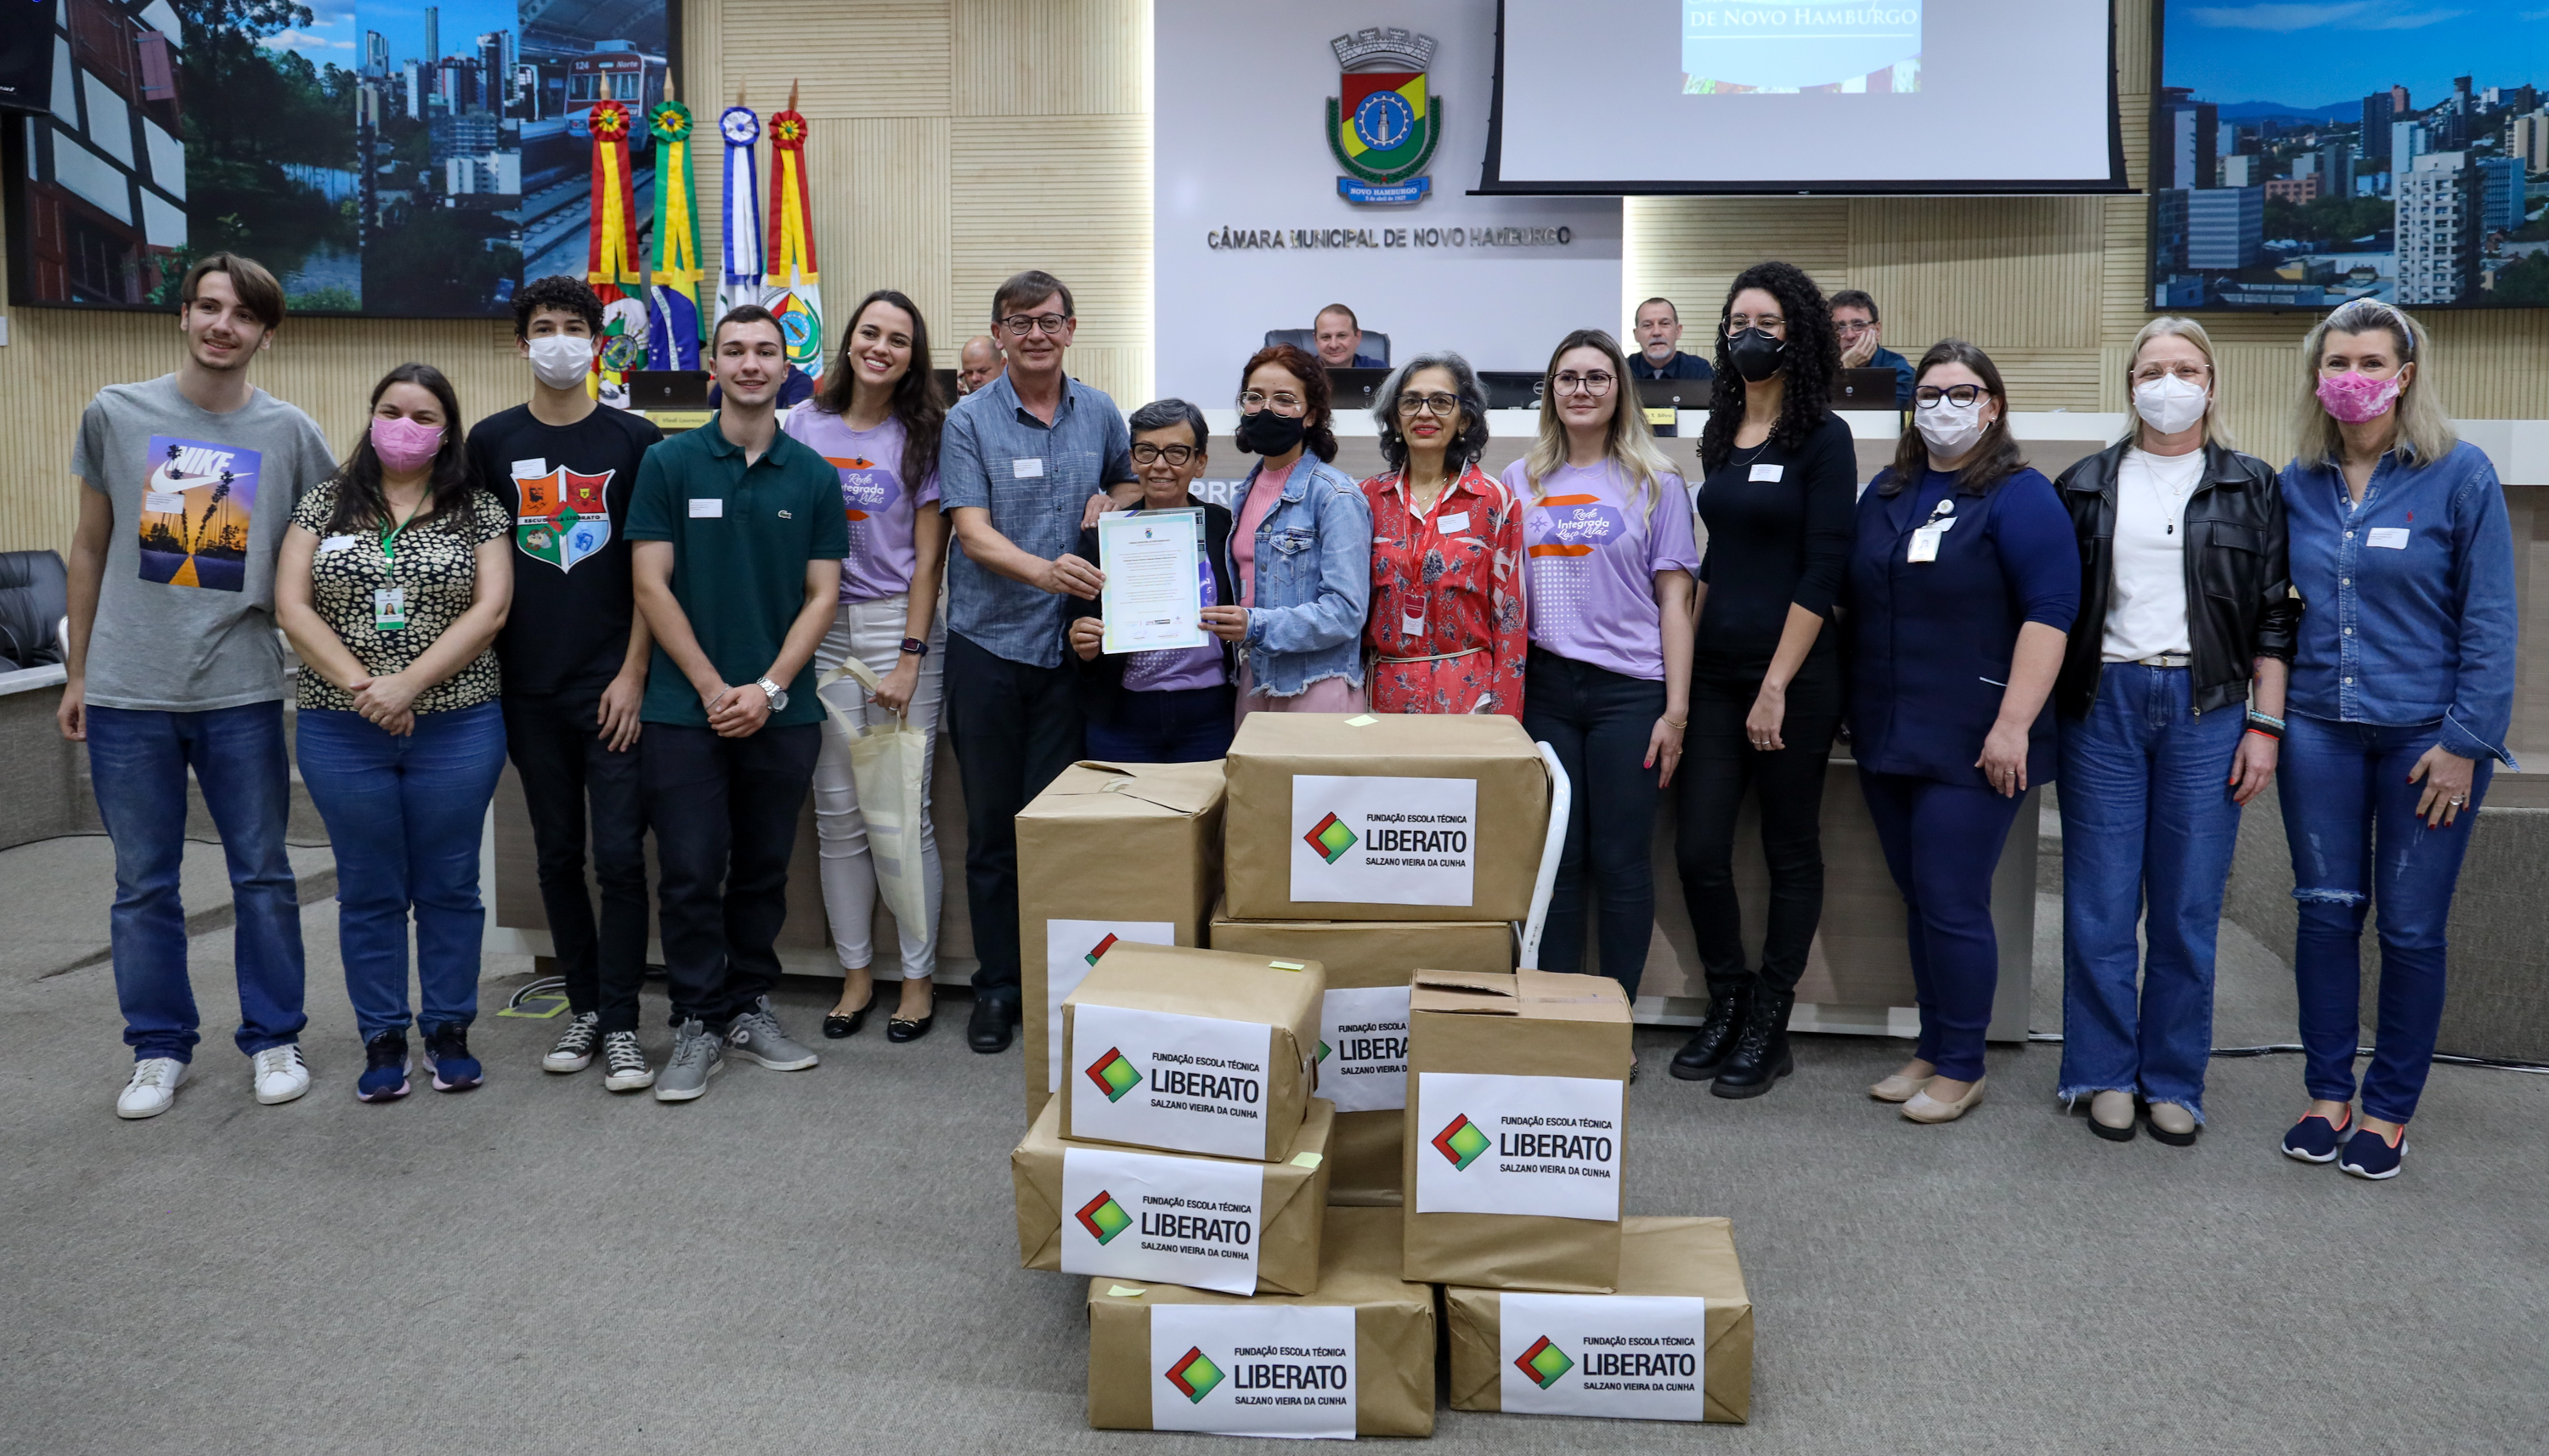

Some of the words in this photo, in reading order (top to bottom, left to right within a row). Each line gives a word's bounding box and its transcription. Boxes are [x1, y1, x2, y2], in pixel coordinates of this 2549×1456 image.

[1689, 11, 1716, 26] DE
[1723, 8, 1787, 26] NOVO
[1794, 7, 1918, 25] HAMBURGO
[575, 61, 590, 70] 124
[1374, 188, 1417, 196] HAMBURGO
[1207, 225, 1286, 250] CÂMARA
[1289, 229, 1379, 249] MUNICIPAL
[1384, 229, 1407, 248] DE
[1414, 228, 1466, 247] NOVO
[1470, 226, 1571, 247] HAMBURGO
[167, 445, 235, 477] NIKE
[848, 473, 873, 486] Rede
[857, 492, 885, 505] Lilás
[1573, 508, 1598, 521] Rede
[1557, 516, 1610, 530] Integrada
[1556, 528, 1580, 542] Laço
[1581, 526, 1609, 539] Lilás
[1366, 812, 1406, 824] FUNDAÇÃO
[1407, 813, 1436, 824] ESCOLA
[1436, 812, 1468, 824] TÉCNICA
[1365, 829, 1467, 853] LIBERATO
[1365, 857, 1400, 866] SALZANO
[1401, 858, 1426, 866] VIEIRA
[1427, 859, 1438, 867] DA
[1439, 859, 1466, 867] CUNHA
[1338, 1023, 1377, 1034] FUNDAÇÃO
[1378, 1022, 1407, 1031] ESCOLA
[1152, 1052, 1194, 1065] FUNDAÇÃO
[1195, 1057, 1226, 1068] ESCOLA
[1227, 1059, 1260, 1072] TÉCNICA
[1340, 1066, 1376, 1075] SALZANO
[1376, 1064, 1401, 1074] VIEIRA
[1401, 1064, 1408, 1073] D
[1150, 1068, 1259, 1103] LIBERATO
[1150, 1098, 1188, 1110] SALZANO
[1189, 1103, 1215, 1114] VIEIRA
[1217, 1105, 1229, 1115] DA
[1229, 1108, 1258, 1119] CUNHA
[1501, 1115, 1544, 1127] FUNDAÇÃO
[1546, 1117, 1577, 1126] ESCOLA
[1578, 1118, 1613, 1129] TÉCNICA
[1500, 1132, 1612, 1162] LIBERATO
[1500, 1163, 1538, 1173] SALZANO
[1539, 1165, 1567, 1174] VIEIRA
[1568, 1166, 1580, 1176] DA
[1581, 1167, 1611, 1178] CUNHA
[1142, 1195, 1185, 1208] FUNDAÇÃO
[1186, 1199, 1217, 1211] ESCOLA
[1218, 1201, 1252, 1214] TÉCNICA
[1141, 1211, 1252, 1245] LIBERATO
[1141, 1241, 1178, 1253] SALZANO
[1179, 1245, 1207, 1256] VIEIRA
[1207, 1248, 1219, 1257] DA
[1220, 1250, 1249, 1261] CUNHA
[1583, 1335, 1627, 1347] FUNDAÇÃO
[1628, 1337, 1660, 1346] ESCOLA
[1661, 1335, 1695, 1346] TÉCNICA
[1234, 1345, 1278, 1357] FUNDAÇÃO
[1280, 1346, 1311, 1357] ESCOLA
[1312, 1346, 1347, 1357] TÉCNICA
[1583, 1352, 1696, 1377] LIBERATO
[1235, 1363, 1347, 1390] LIBERATO
[1583, 1381, 1622, 1391] SALZANO
[1623, 1382, 1651, 1391] VIEIRA
[1652, 1383, 1664, 1391] DA
[1665, 1383, 1695, 1391] CUNHA
[1235, 1396, 1274, 1406] SALZANO
[1274, 1397, 1303, 1406] VIEIRA
[1303, 1397, 1316, 1406] DA
[1317, 1397, 1347, 1406] CUNHA
